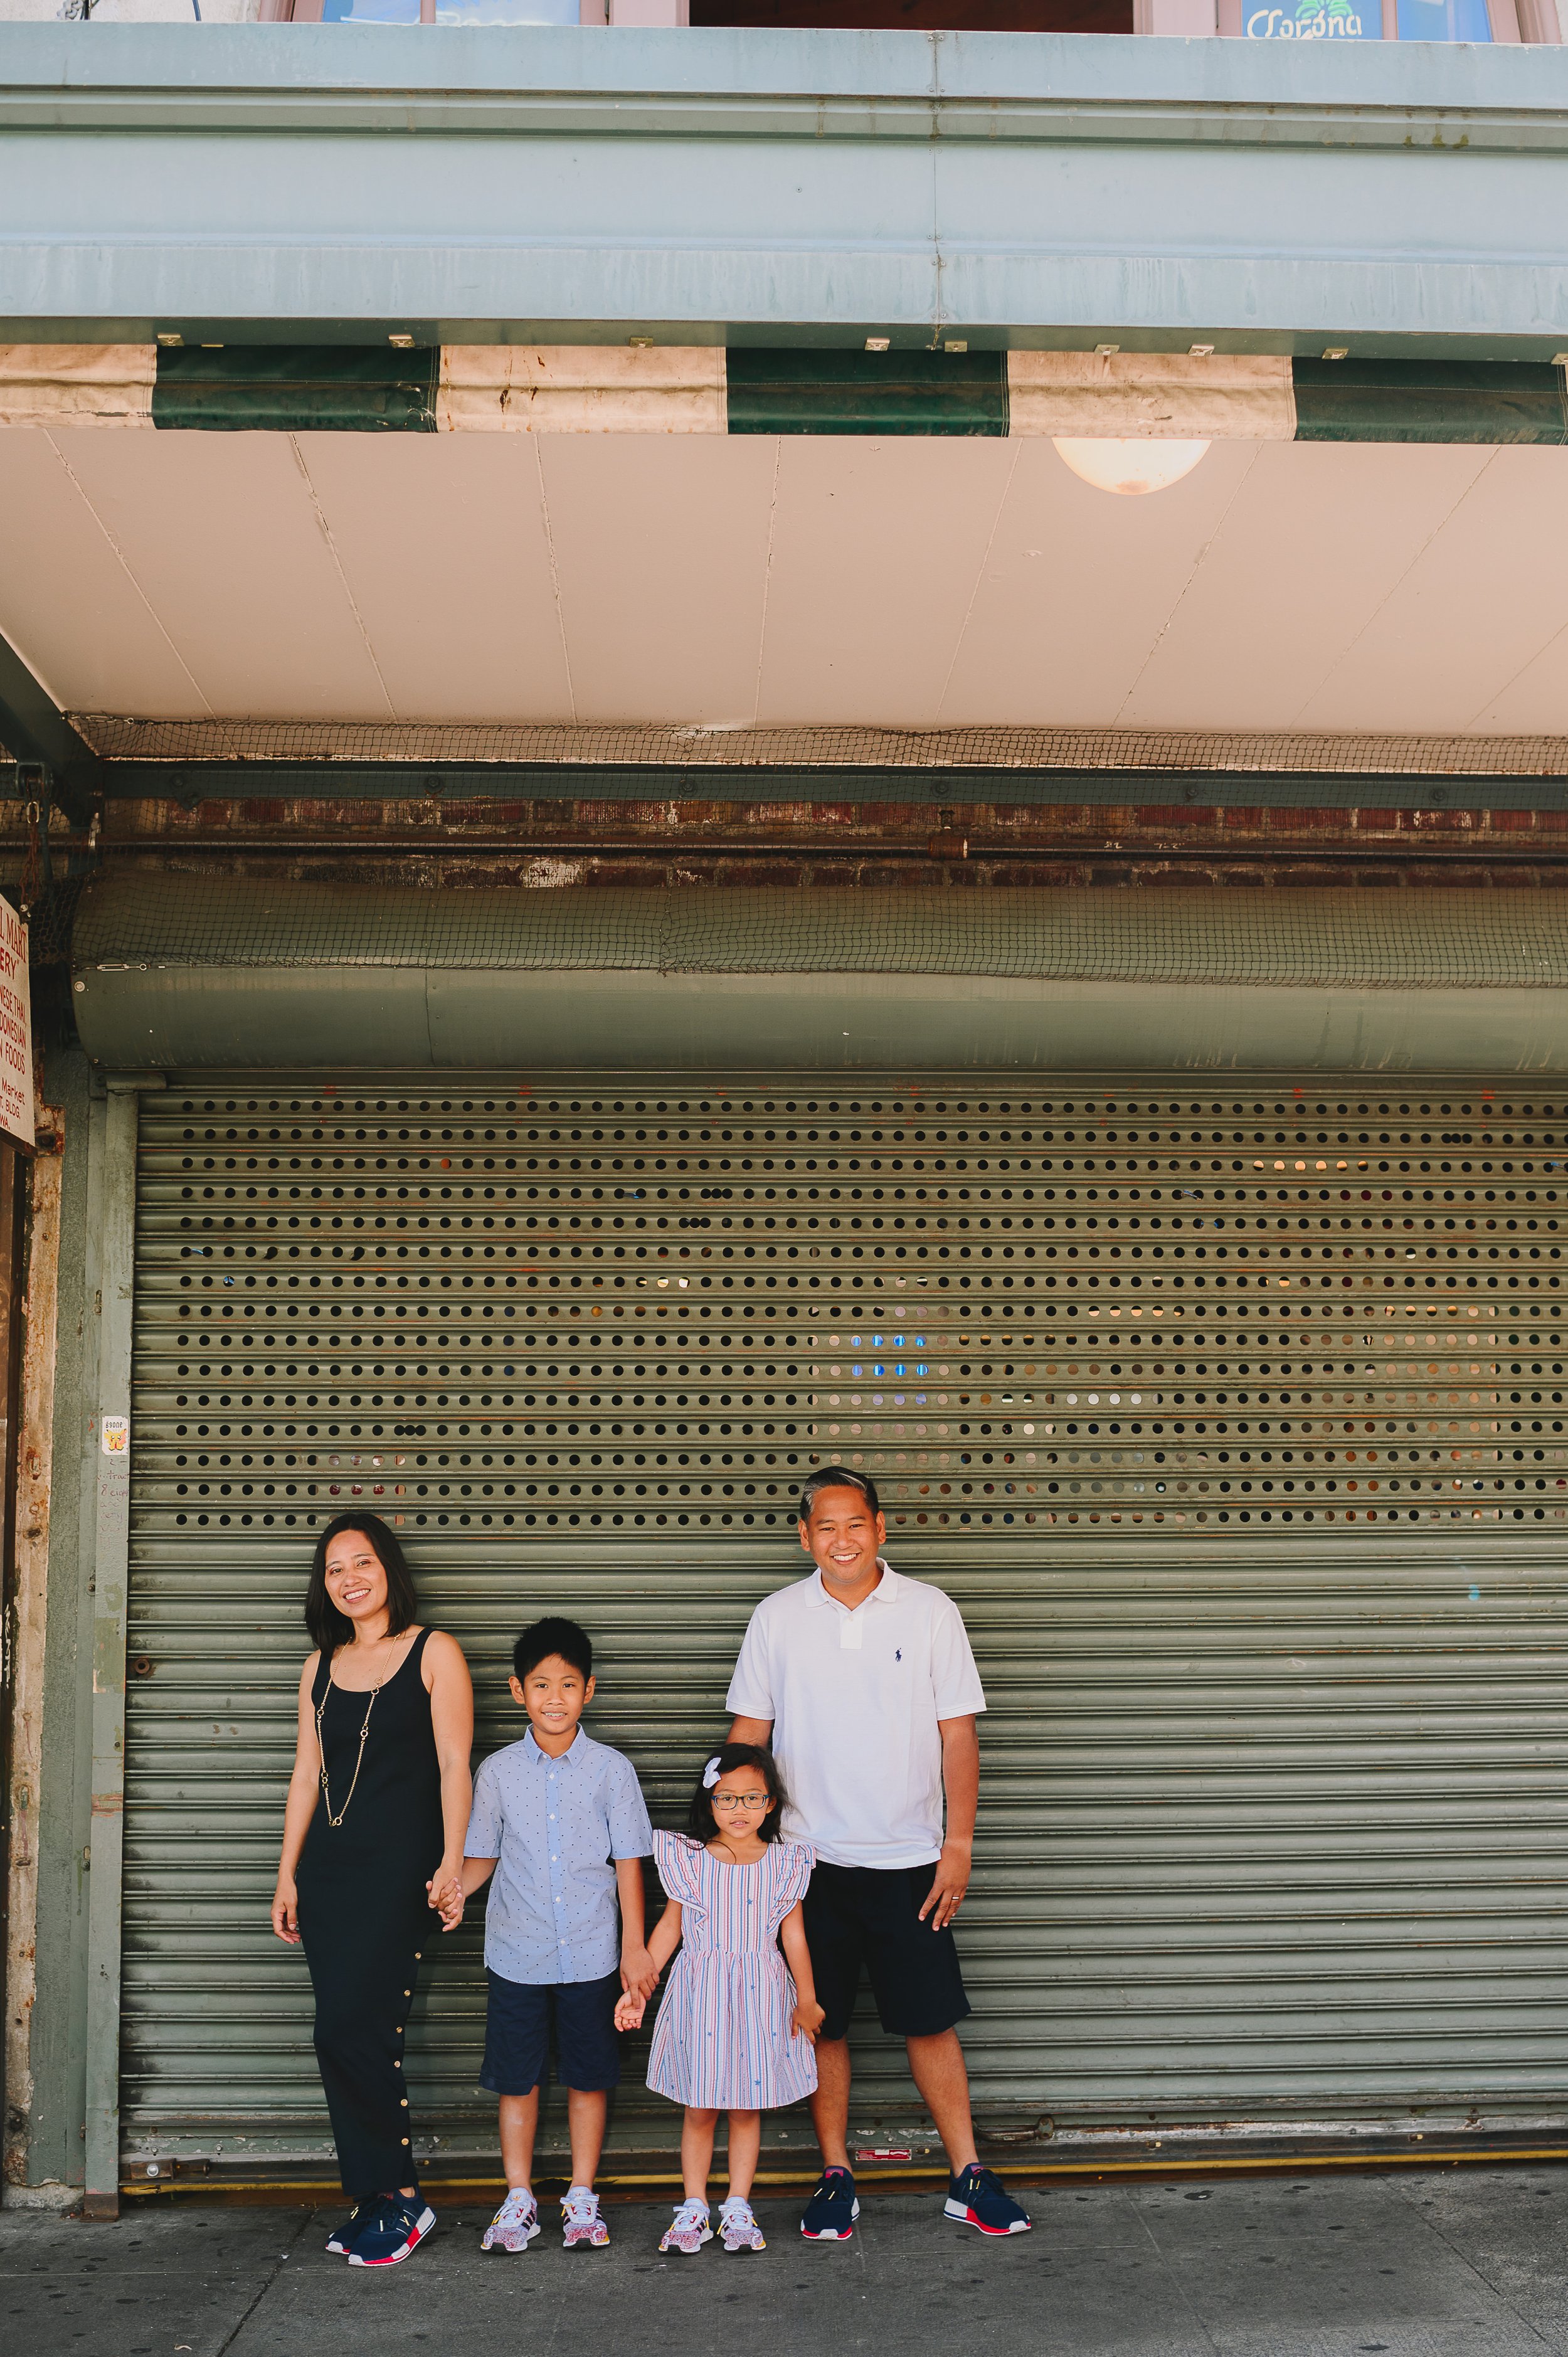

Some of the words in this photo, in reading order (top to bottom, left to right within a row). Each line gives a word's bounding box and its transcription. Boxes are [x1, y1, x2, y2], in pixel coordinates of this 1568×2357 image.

[1247, 9, 1362, 40] Corona
[6, 913, 27, 964] MART
[6, 1041, 25, 1075] FOODS
[2, 1077, 25, 1106] Market
[6, 1099, 21, 1120] BLDG.
